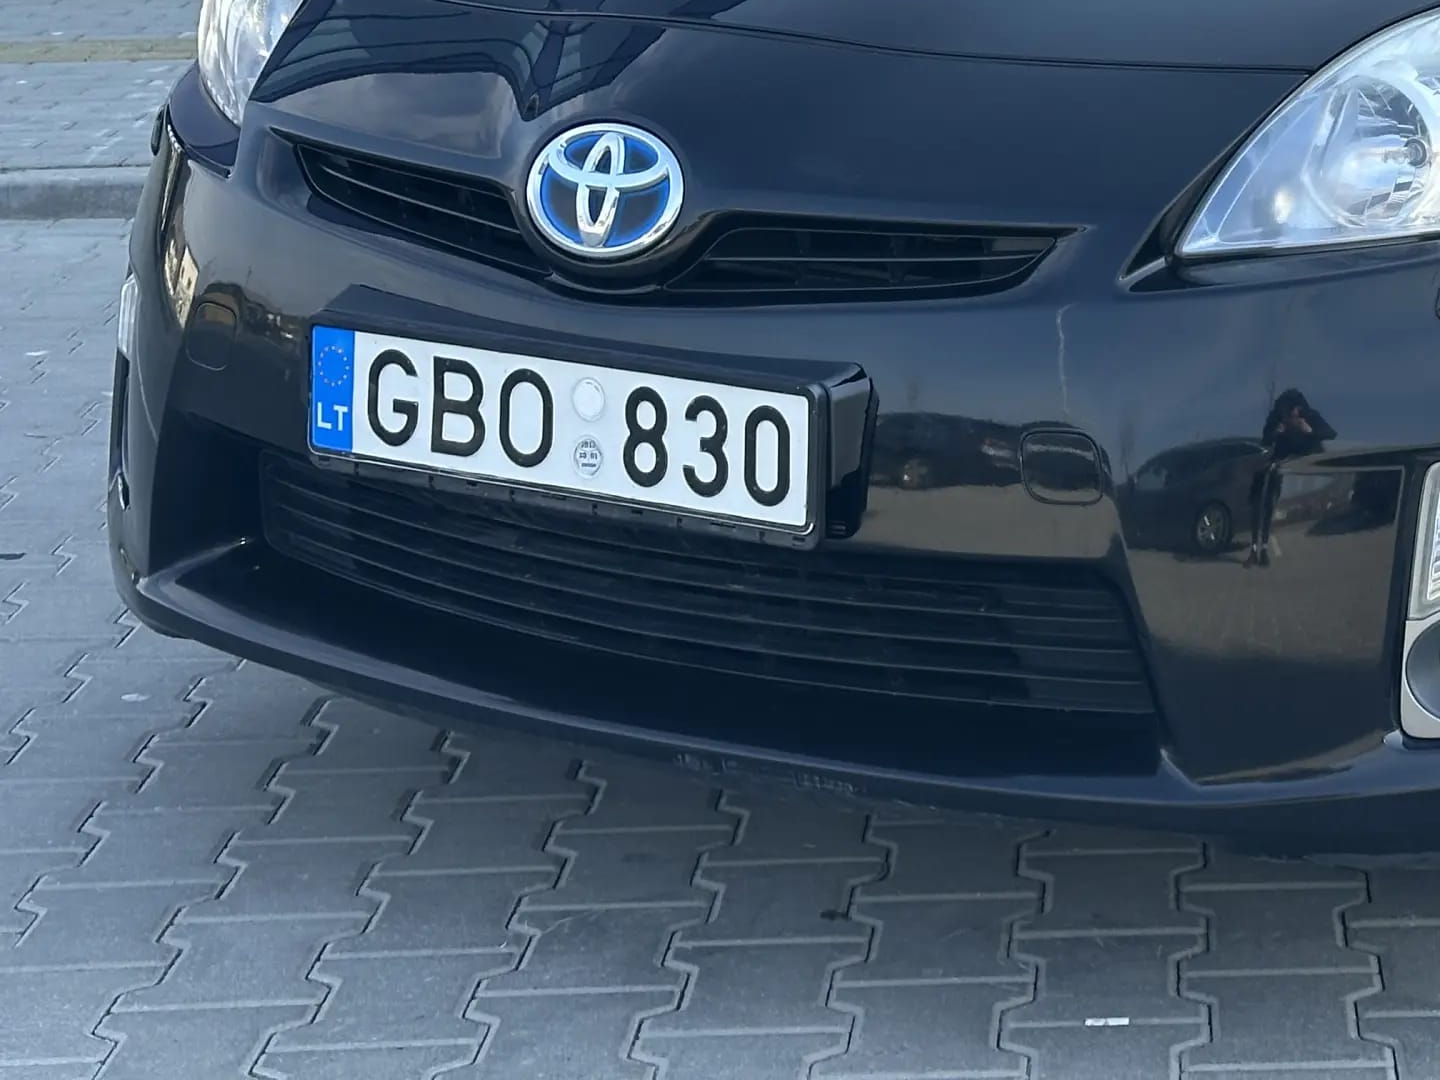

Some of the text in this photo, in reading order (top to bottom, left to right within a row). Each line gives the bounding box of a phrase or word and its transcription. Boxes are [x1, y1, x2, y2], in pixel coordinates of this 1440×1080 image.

[316, 402, 349, 432] LT
[367, 349, 791, 507] GBO 830
